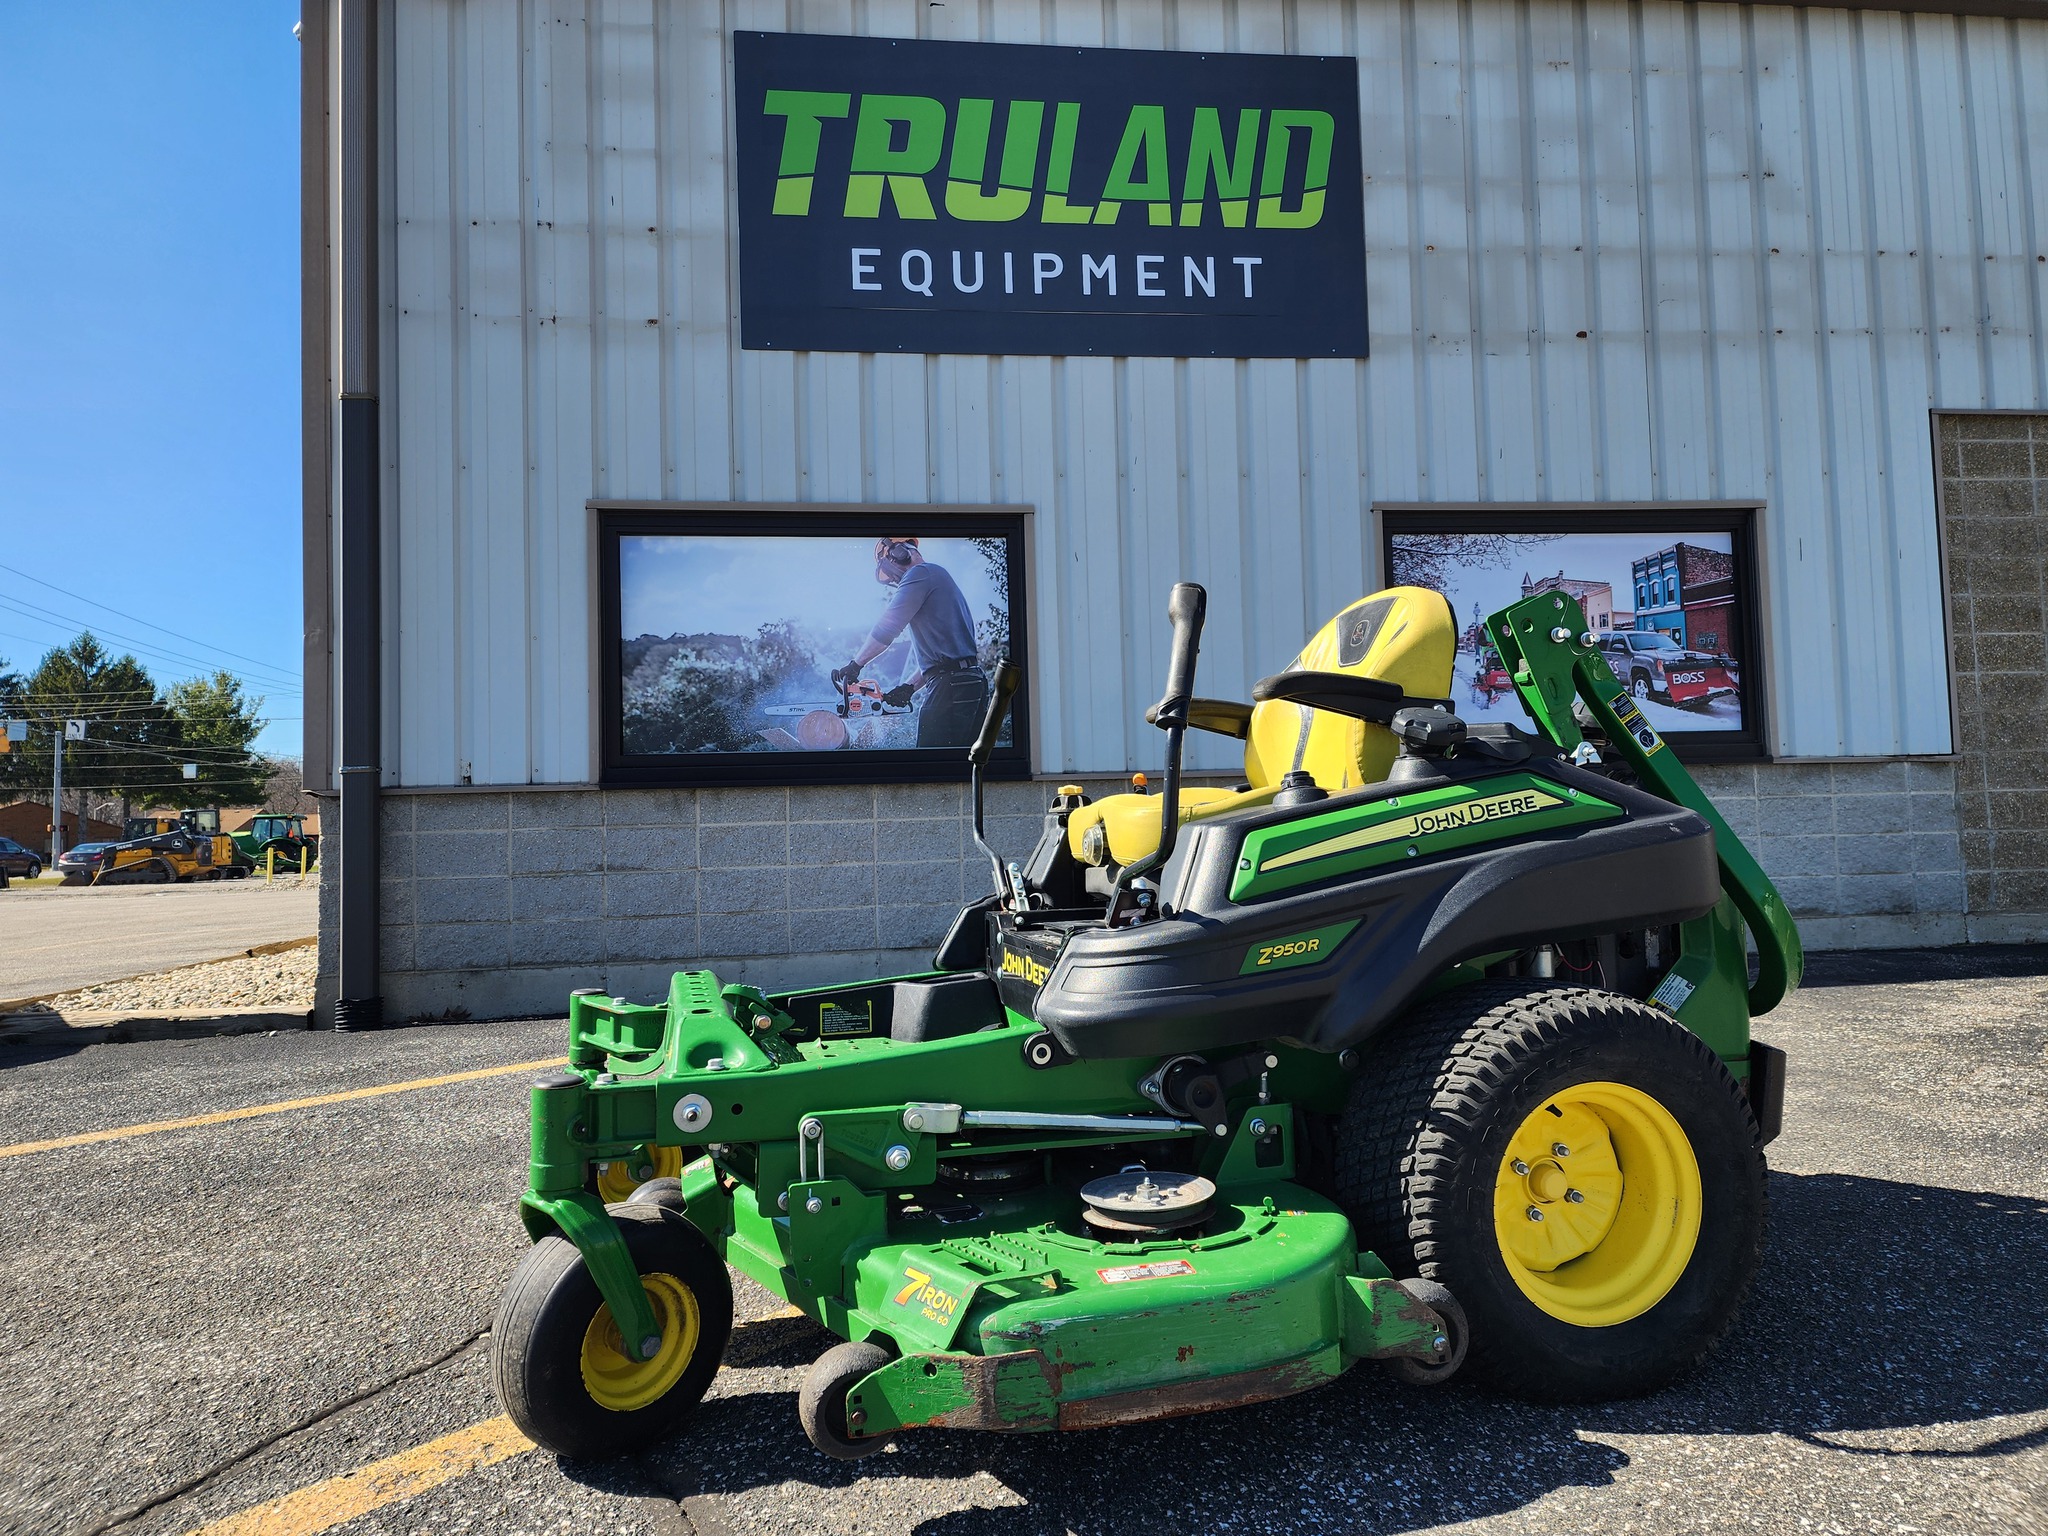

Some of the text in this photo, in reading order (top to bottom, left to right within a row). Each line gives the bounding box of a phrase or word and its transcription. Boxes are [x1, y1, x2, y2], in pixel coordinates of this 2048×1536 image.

[763, 89, 1335, 229] TRULAND
[851, 248, 1263, 298] EQUIPMENT
[1672, 671, 1706, 684] BOSS
[1409, 795, 1538, 835] JOHN DEERE
[115, 843, 133, 851] DEERE
[1002, 946, 1025, 978] JOHN
[920, 1307, 949, 1327] PRO 60
